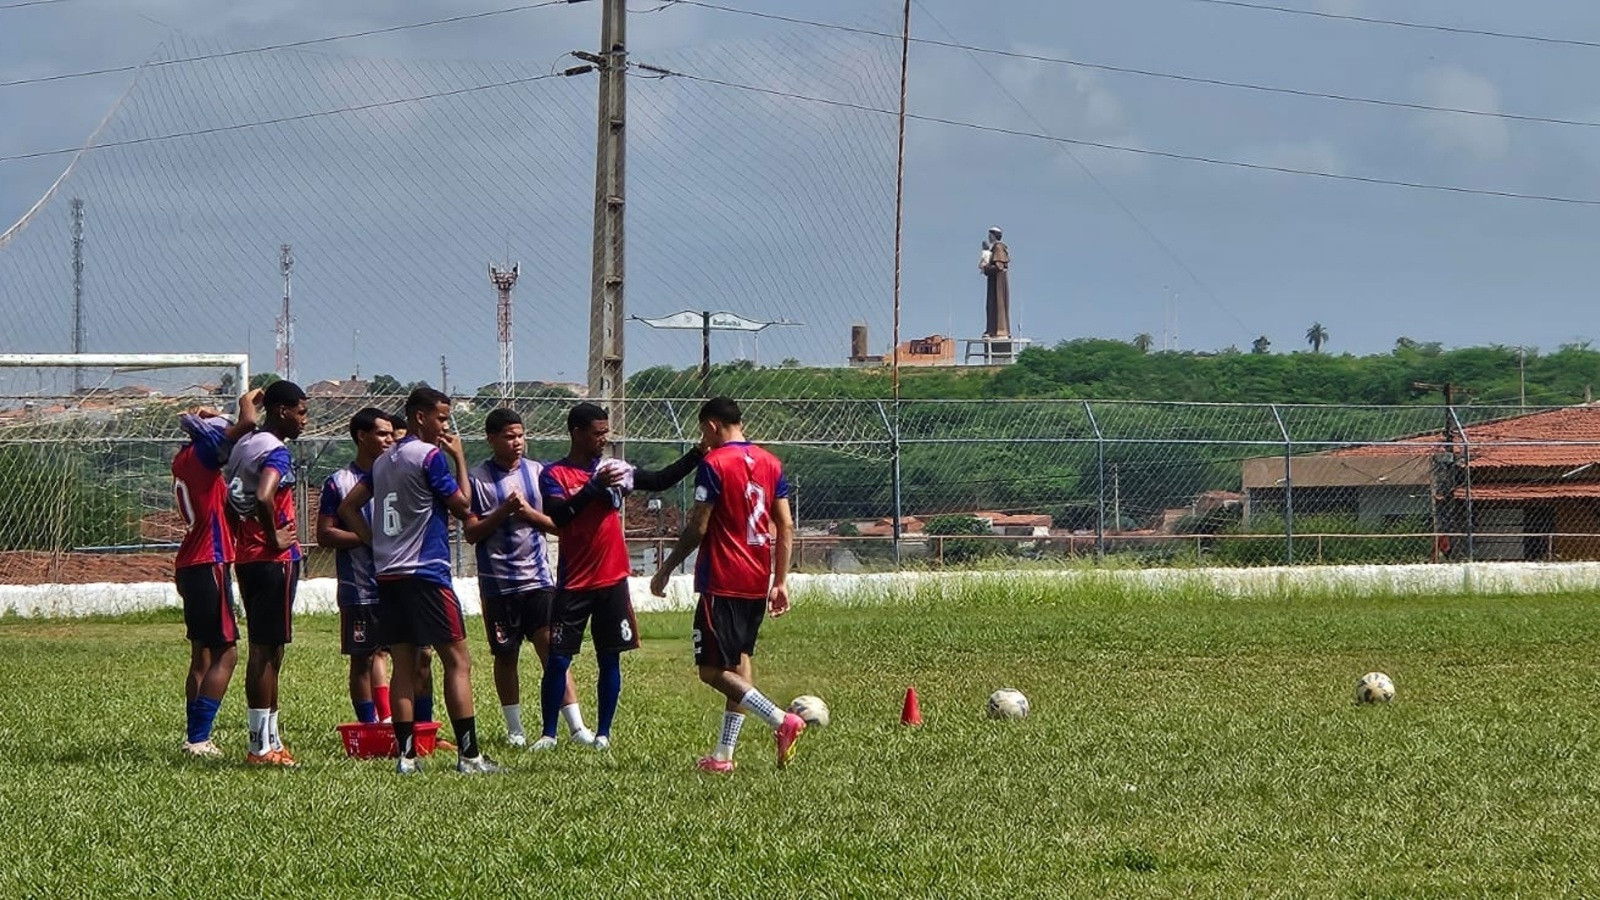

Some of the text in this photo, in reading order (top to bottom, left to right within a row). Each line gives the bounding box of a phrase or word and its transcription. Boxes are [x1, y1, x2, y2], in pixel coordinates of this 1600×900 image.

[383, 491, 401, 536] 6
[744, 481, 773, 546] 2
[620, 618, 632, 641] 8
